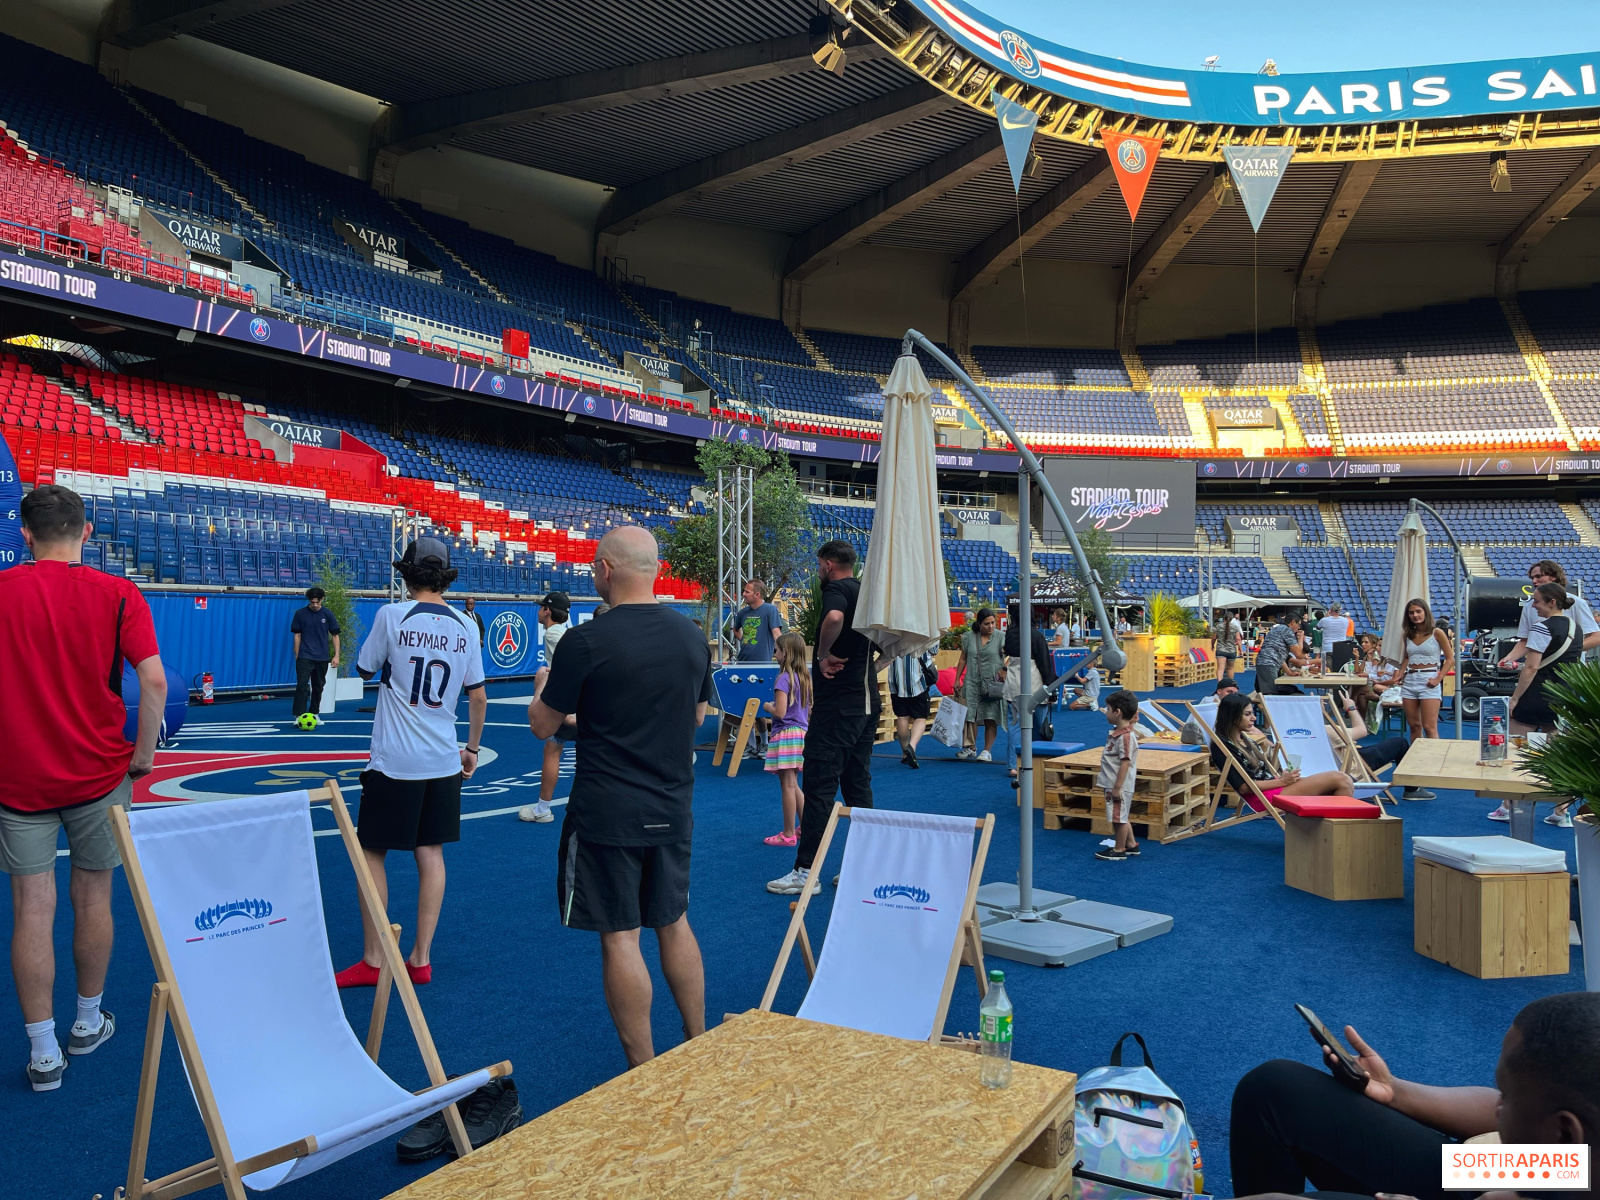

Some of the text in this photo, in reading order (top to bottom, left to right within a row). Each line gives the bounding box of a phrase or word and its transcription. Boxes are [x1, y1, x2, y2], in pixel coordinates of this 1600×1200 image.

[1003, 33, 1029, 50] PARIS
[1253, 65, 1597, 115] PARIS SAI
[1122, 141, 1142, 152] PARIS
[1232, 158, 1278, 172] QATAR
[1243, 169, 1278, 178] AIRWAYS
[168, 220, 220, 247] QATAR
[345, 223, 398, 254] ATAR
[182, 238, 221, 256] AIRWAYS
[0, 259, 97, 300] STADIUM TOUR
[327, 338, 391, 367] STADIUM TOUR
[640, 357, 669, 372] QATAR
[628, 407, 668, 427] STADIUM TOUR
[1224, 409, 1263, 421] QATAR
[270, 422, 323, 444] QATAR
[777, 437, 817, 453] STADIUM TOUR
[935, 454, 973, 467] TADIUM TOUR
[1555, 459, 1589, 470] STADIUM
[1349, 463, 1401, 474] STADIUM TOUR
[1070, 487, 1169, 508] STADIUM TOUR
[958, 510, 990, 521] QATAR
[1240, 516, 1277, 527] QATAR
[1033, 588, 1061, 597] BAR
[495, 614, 522, 628] PARIS
[398, 629, 449, 652] NEYMAR
[408, 655, 451, 709] 10
[242, 923, 265, 933] PRINCES
